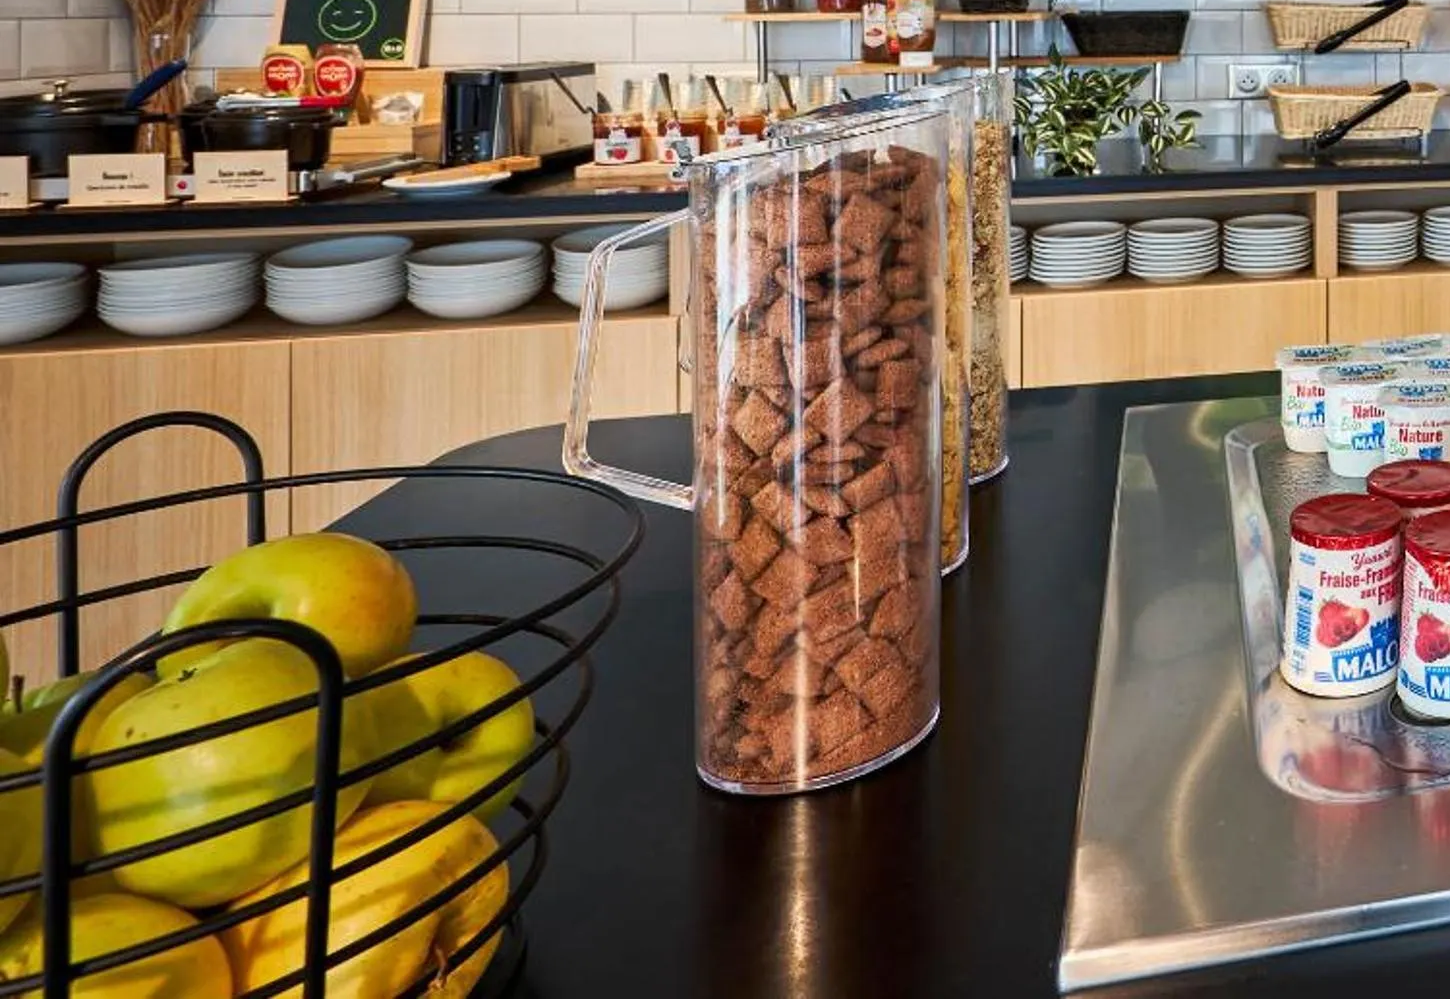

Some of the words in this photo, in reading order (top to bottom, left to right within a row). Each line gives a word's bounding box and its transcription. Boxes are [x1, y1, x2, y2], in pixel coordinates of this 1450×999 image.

[1296, 385, 1325, 397] Natu
[1353, 405, 1385, 418] Natu
[1354, 436, 1384, 449] MAL
[1399, 428, 1443, 443] Nature
[1319, 562, 1400, 588] Fraise-Fram
[1337, 641, 1399, 682] MALO
